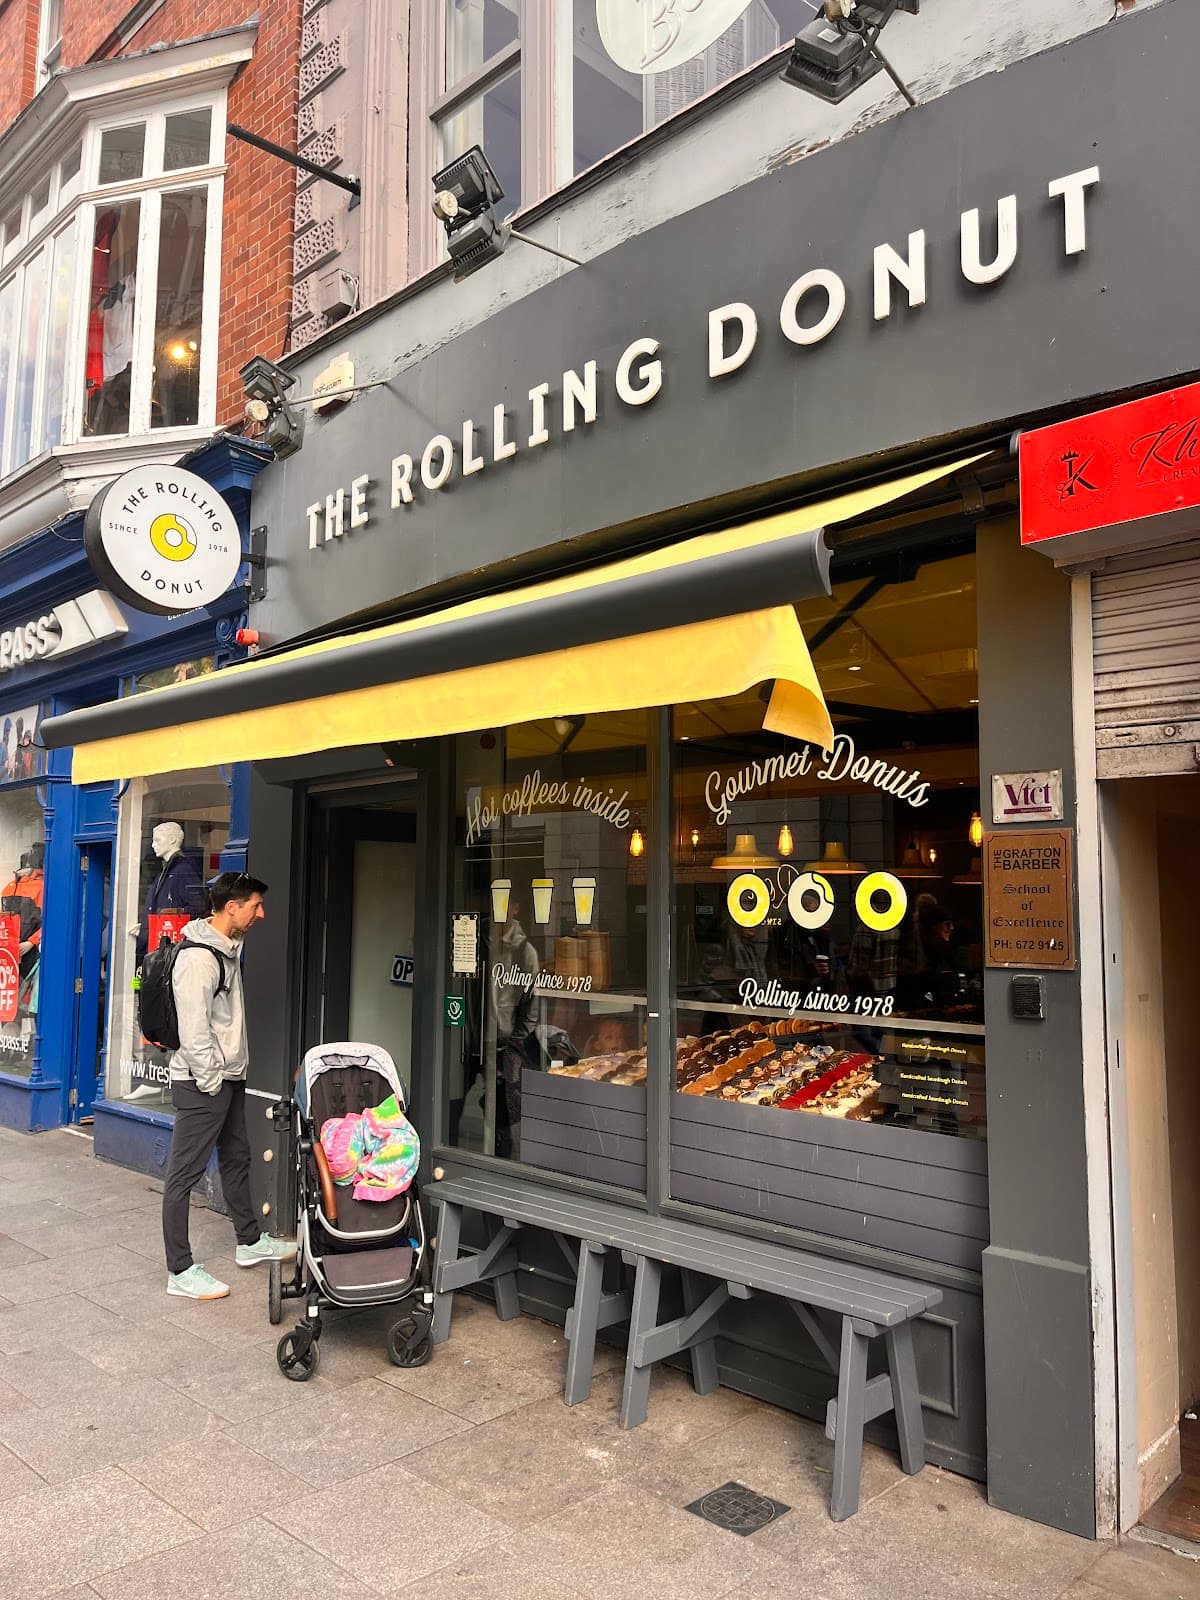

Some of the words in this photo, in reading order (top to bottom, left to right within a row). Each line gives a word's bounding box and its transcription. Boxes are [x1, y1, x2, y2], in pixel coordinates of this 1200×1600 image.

[306, 473, 369, 550] THE
[391, 337, 662, 509] ROLLING
[708, 165, 1100, 378] DONUT
[122, 487, 149, 514] THE
[155, 482, 222, 533] ROLLING
[108, 522, 138, 535] SINCE
[208, 543, 228, 553] 1978
[140, 569, 204, 595] DONUT
[0, 614, 52, 672] PASS
[705, 745, 812, 826] Gourmet
[817, 734, 929, 807] Donuts
[502, 769, 570, 818] coffees
[572, 777, 631, 829] inside
[994, 849, 1002, 870] THE
[1003, 848, 1061, 858] GRAFTON
[1003, 859, 1061, 870] BARBER
[1003, 884, 1050, 895] School
[1021, 901, 1033, 910] of
[993, 917, 1064, 928] Excellence
[994, 940, 1012, 949] PH:
[1016, 940, 1034, 949] 672
[393, 960, 414, 980] OP
[492, 962, 534, 994] Rolling
[534, 969, 564, 989] since
[566, 976, 592, 993] 1978
[738, 977, 802, 1015] Rolling
[803, 987, 850, 1012] since
[854, 996, 895, 1017] 1978
